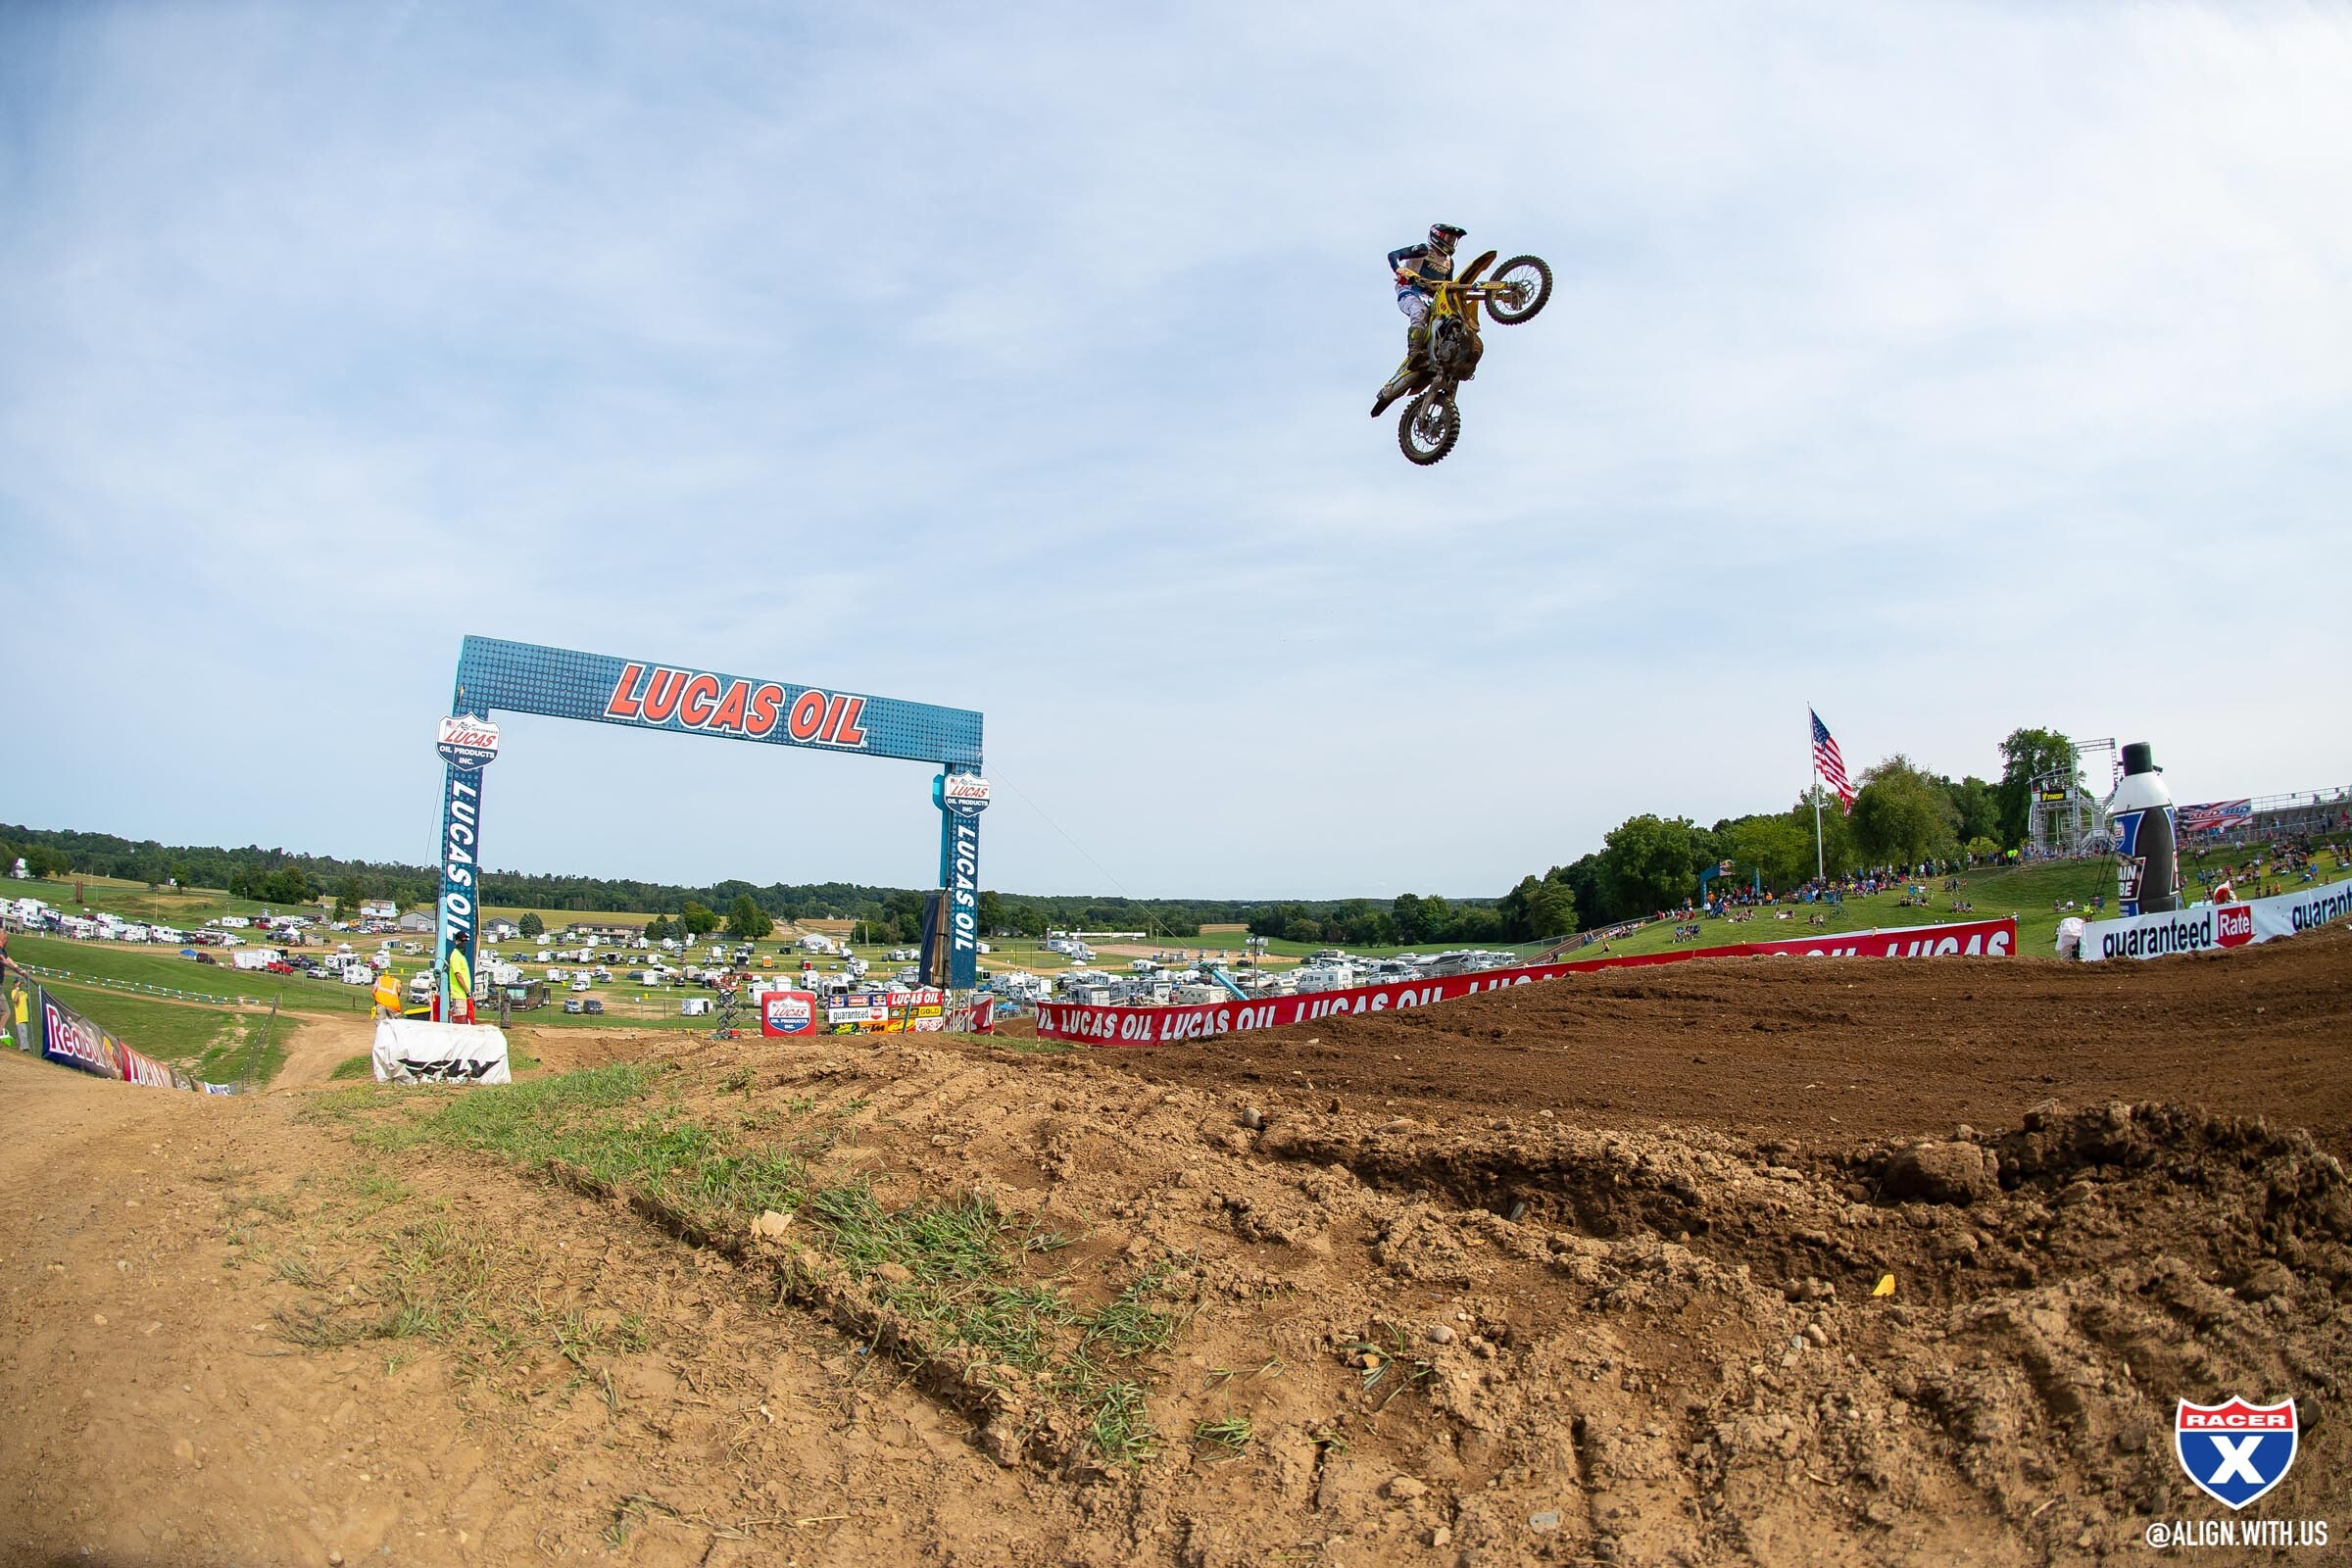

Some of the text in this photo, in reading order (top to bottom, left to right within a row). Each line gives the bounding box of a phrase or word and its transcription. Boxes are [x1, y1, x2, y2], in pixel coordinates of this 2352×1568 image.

[604, 662, 868, 748] LUCAS OIL
[444, 729, 497, 747] LUCAS
[439, 745, 495, 760] OIL PRODUCTS
[459, 757, 474, 765] INC.
[951, 785, 988, 798] LUCAS
[446, 779, 477, 941] LUCAS OIL
[955, 824, 976, 951] LUCAS OIL
[2102, 910, 2251, 959] guaranteed Rate
[891, 993, 923, 1005] LUCAS
[924, 992, 939, 1004] OIL
[773, 1007, 807, 1017] LUCAS
[833, 1007, 869, 1022] guaranteed
[1061, 1009, 1118, 1039] LUCAS
[1121, 1013, 1152, 1041] OIL
[1159, 1009, 1230, 1041] LUCAS
[1237, 1005, 1276, 1030] OIL
